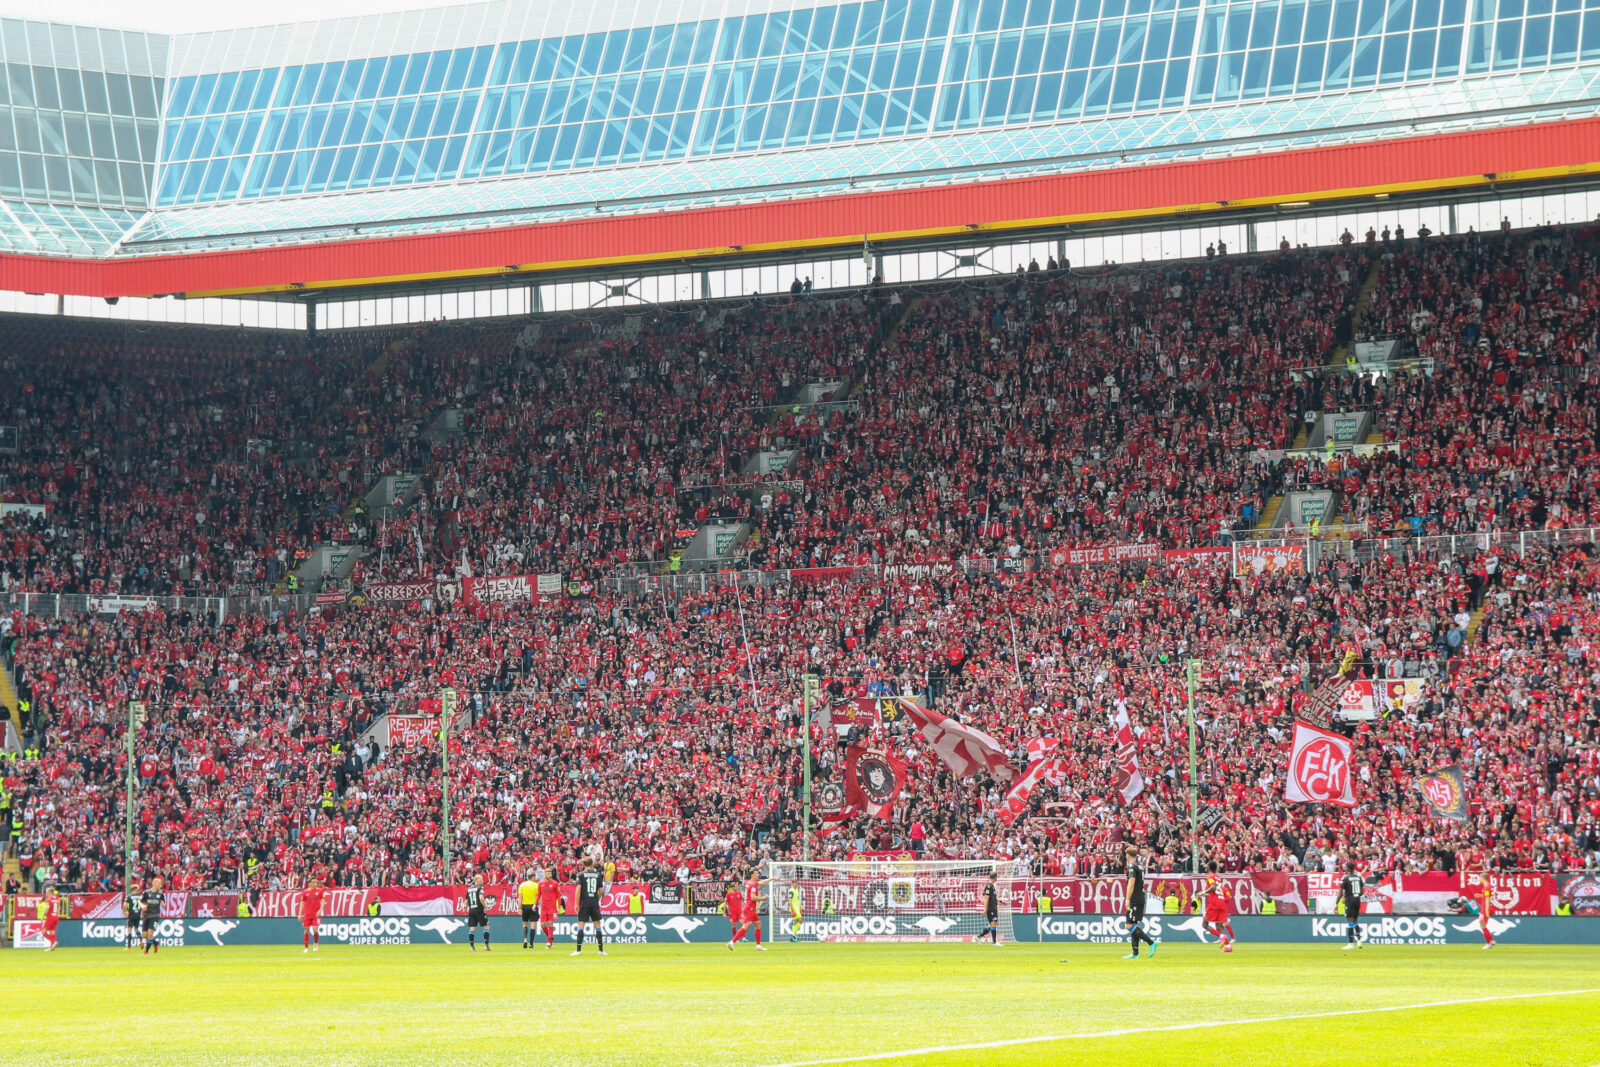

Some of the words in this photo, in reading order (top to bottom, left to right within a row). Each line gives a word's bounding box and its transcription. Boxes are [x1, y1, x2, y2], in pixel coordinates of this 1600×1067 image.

[1070, 549, 1105, 563] BETZE
[349, 937, 378, 945] SUPER
[380, 937, 411, 945] SHOES
